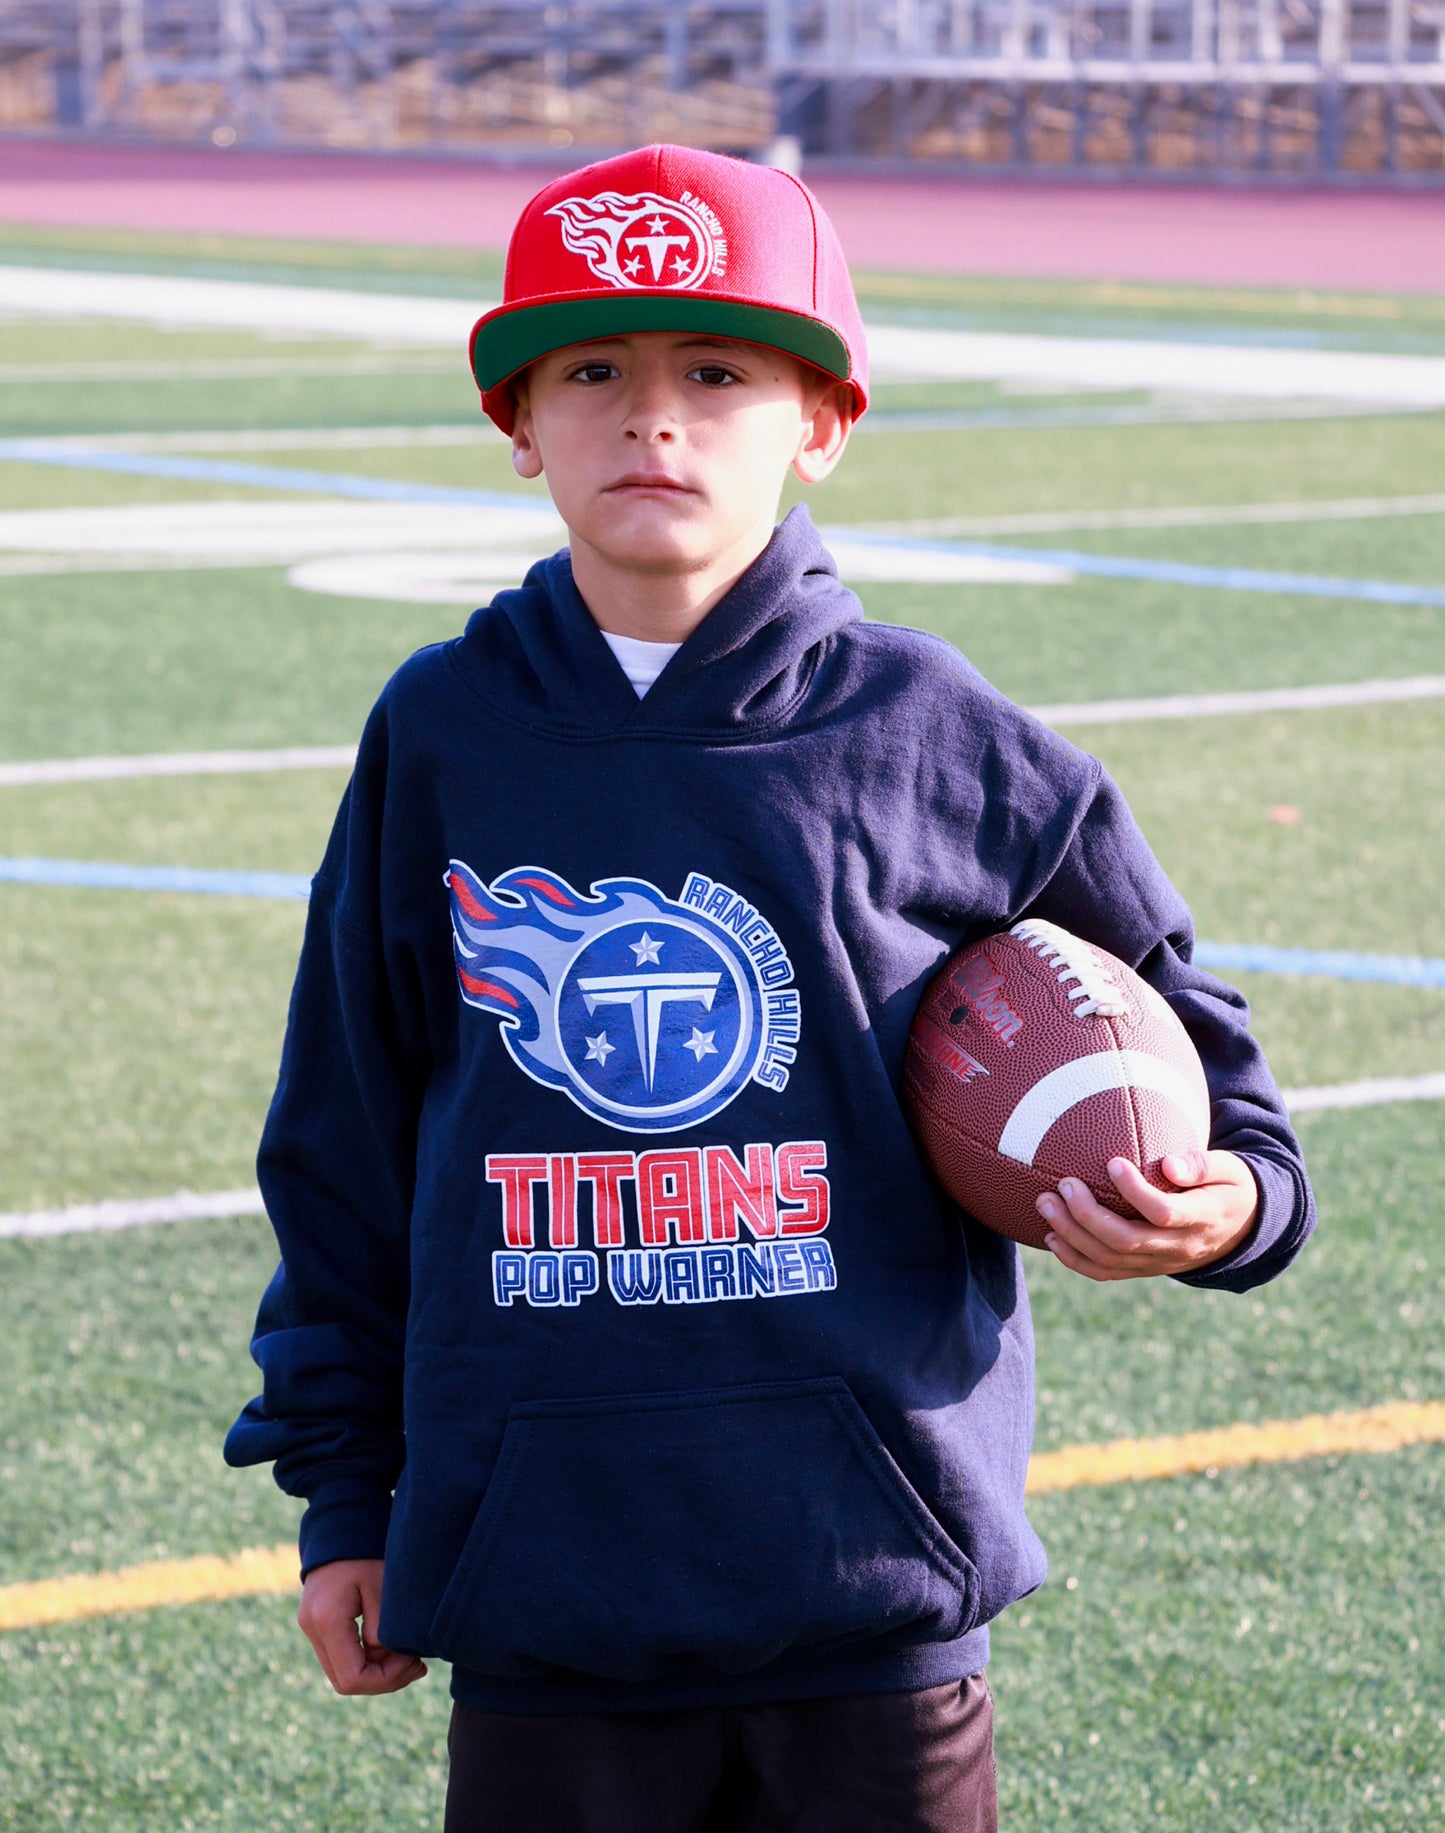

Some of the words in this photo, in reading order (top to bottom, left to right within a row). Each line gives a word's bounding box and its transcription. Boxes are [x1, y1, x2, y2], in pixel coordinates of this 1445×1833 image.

[679, 190, 723, 237] RANCHO
[680, 872, 794, 991] RANCHO
[752, 988, 801, 1093] HILLS
[485, 1140, 832, 1249] TITANS
[492, 1250, 599, 1307] POP
[606, 1237, 837, 1306] WARNER
